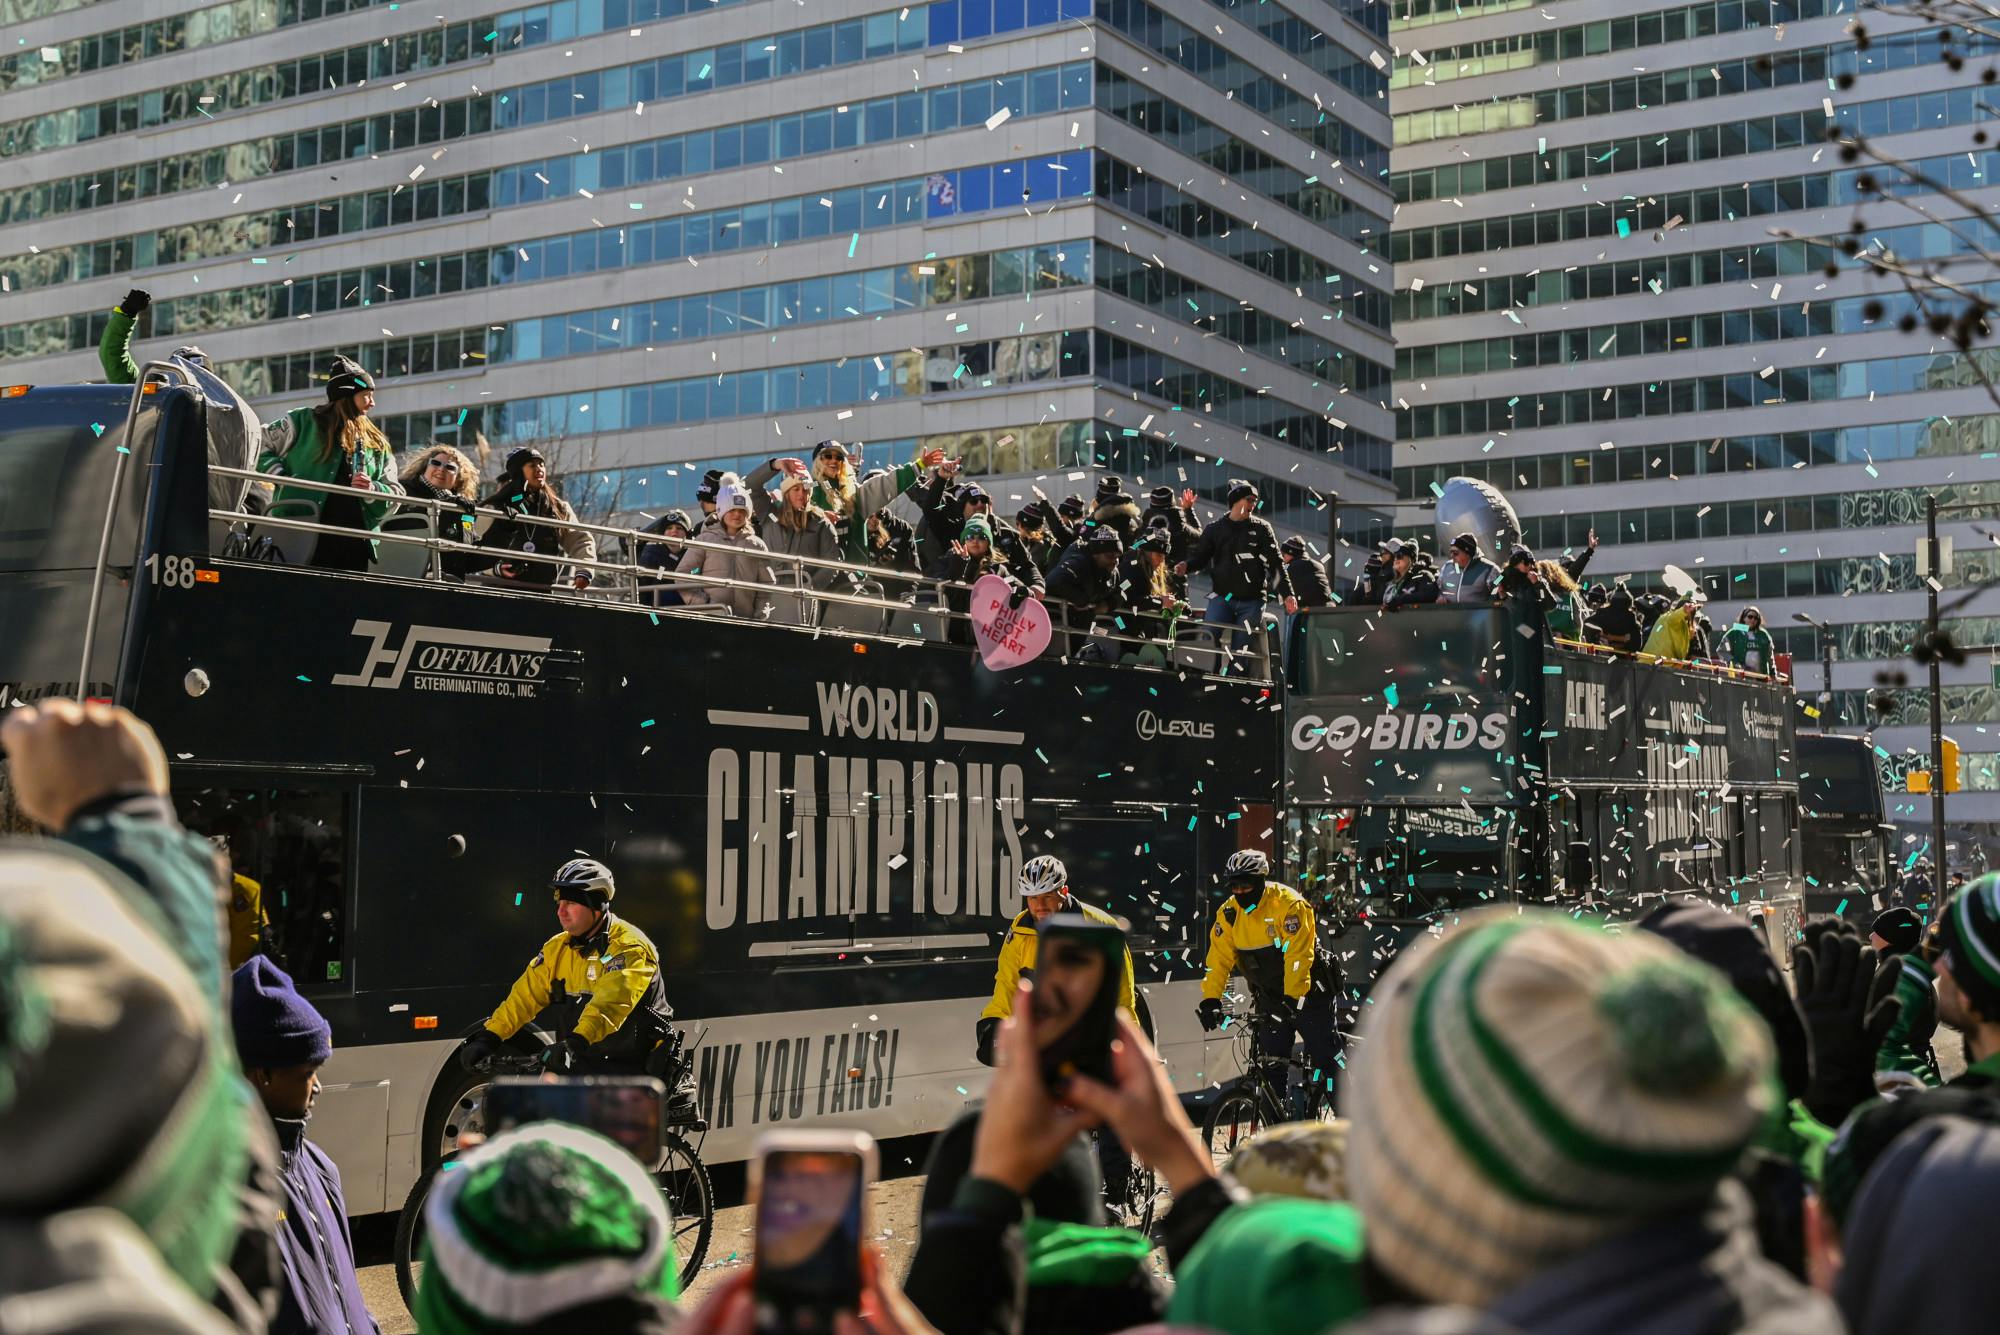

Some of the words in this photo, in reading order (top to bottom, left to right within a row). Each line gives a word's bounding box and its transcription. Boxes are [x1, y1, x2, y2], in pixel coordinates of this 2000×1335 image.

[144, 553, 195, 589] 188
[990, 600, 1036, 632] PHILLY
[994, 618, 1023, 639] GOT
[981, 624, 1026, 656] HEART
[414, 676, 494, 695] EXTERMINATING
[496, 684, 515, 697] CO.,
[517, 684, 537, 698] INC.
[1565, 680, 1608, 730] ACME
[816, 681, 939, 743] WORLD
[1158, 719, 1215, 738] LEXUS
[1670, 700, 1703, 736] WORLD
[1291, 714, 1361, 750] GO
[1369, 712, 1508, 750] BIRDS
[705, 748, 1025, 930] CHAMPIONS
[752, 1037, 810, 1124] YOU
[817, 1029, 899, 1115] FANS!
